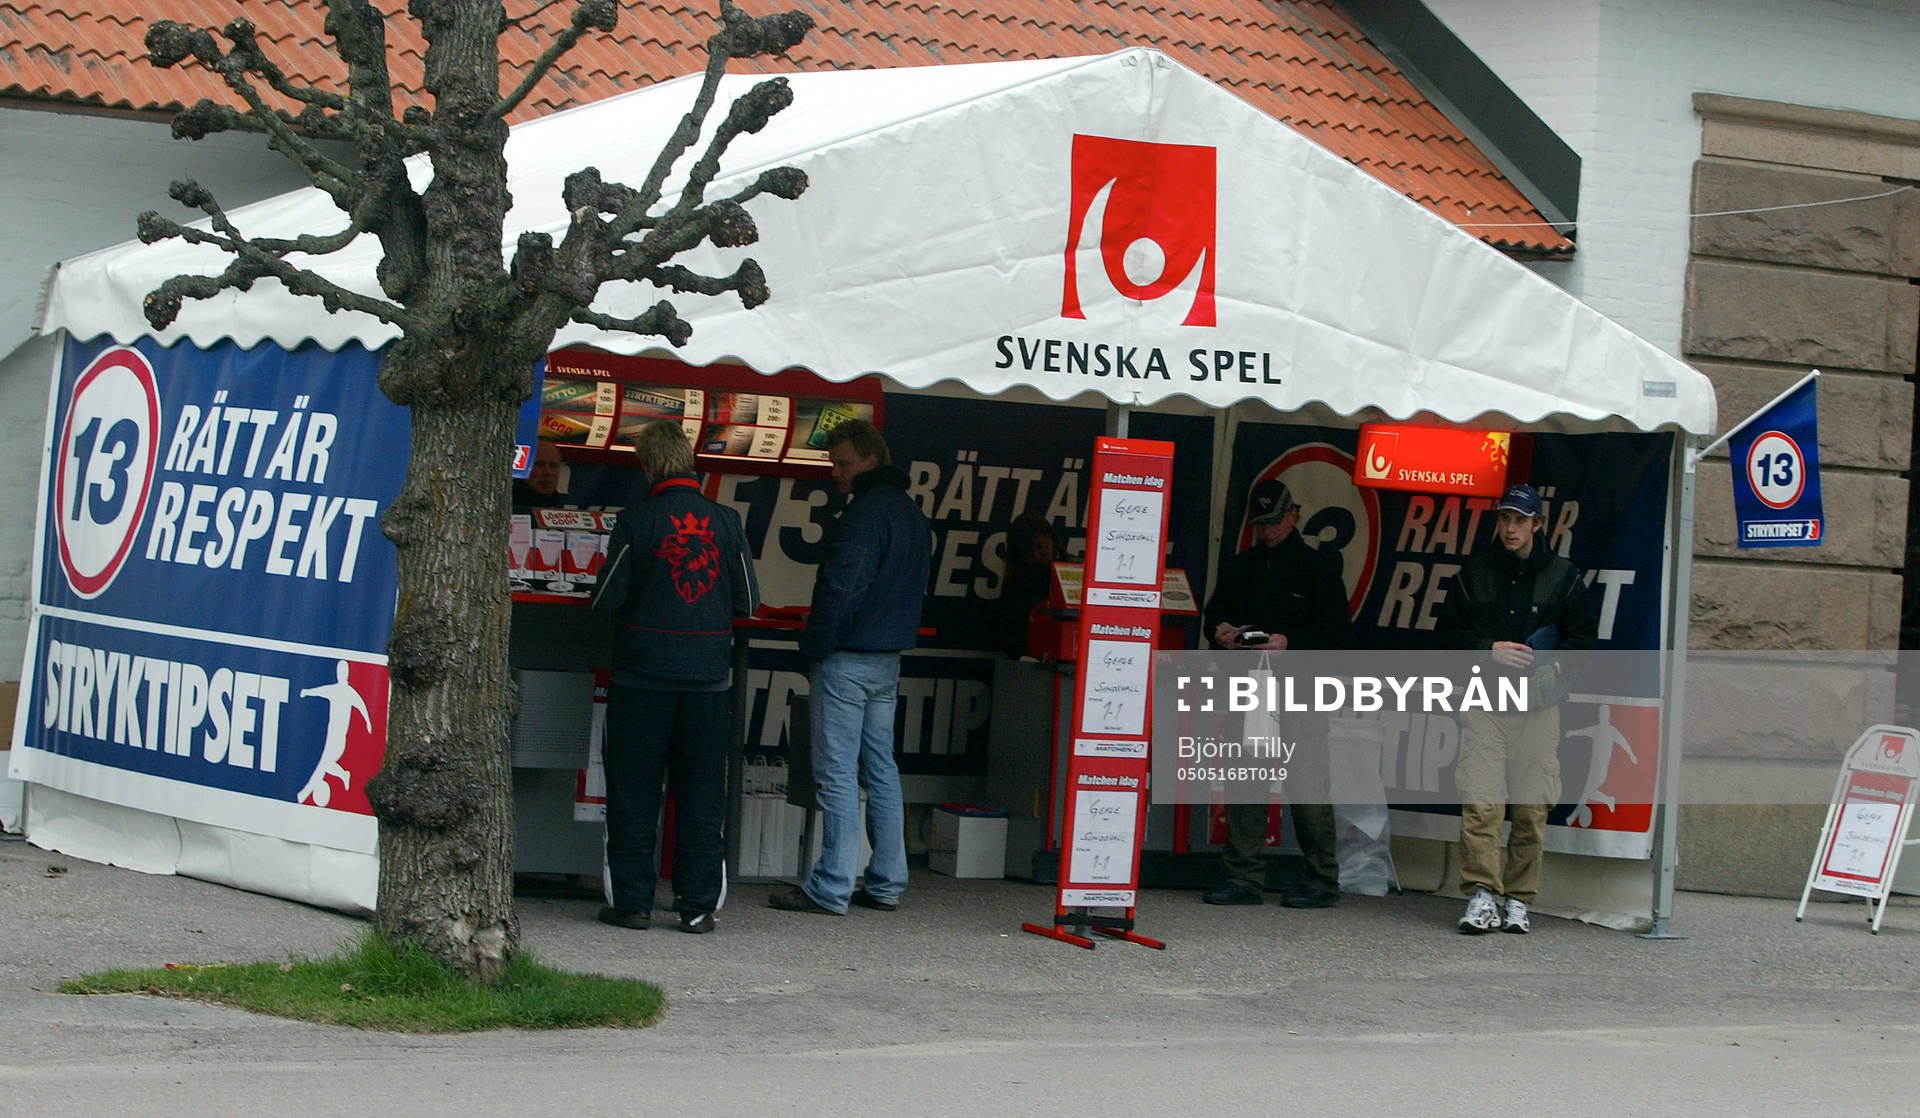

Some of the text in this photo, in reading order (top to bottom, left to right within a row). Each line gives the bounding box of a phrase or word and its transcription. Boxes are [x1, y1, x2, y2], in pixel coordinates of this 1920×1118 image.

[557, 366, 611, 378] SVENSKA SPEL
[994, 335, 1282, 385] SVENSKA SPEL
[163, 390, 338, 484] RÄTT ÄR
[541, 416, 573, 435] Keno
[72, 416, 140, 525] 13
[1103, 472, 1164, 488] Matchen idag
[1399, 468, 1475, 486] SVENSKA SPEL
[1758, 453, 1793, 487] 13
[908, 450, 1043, 523] RÄTT
[144, 481, 379, 584] RESPEKT
[1747, 523, 1803, 538] STRYKTIPSET
[1090, 624, 1151, 639] Matchen idag
[44, 640, 290, 773] STRYKTIPSET
[1078, 774, 1139, 788] Matchen idag
